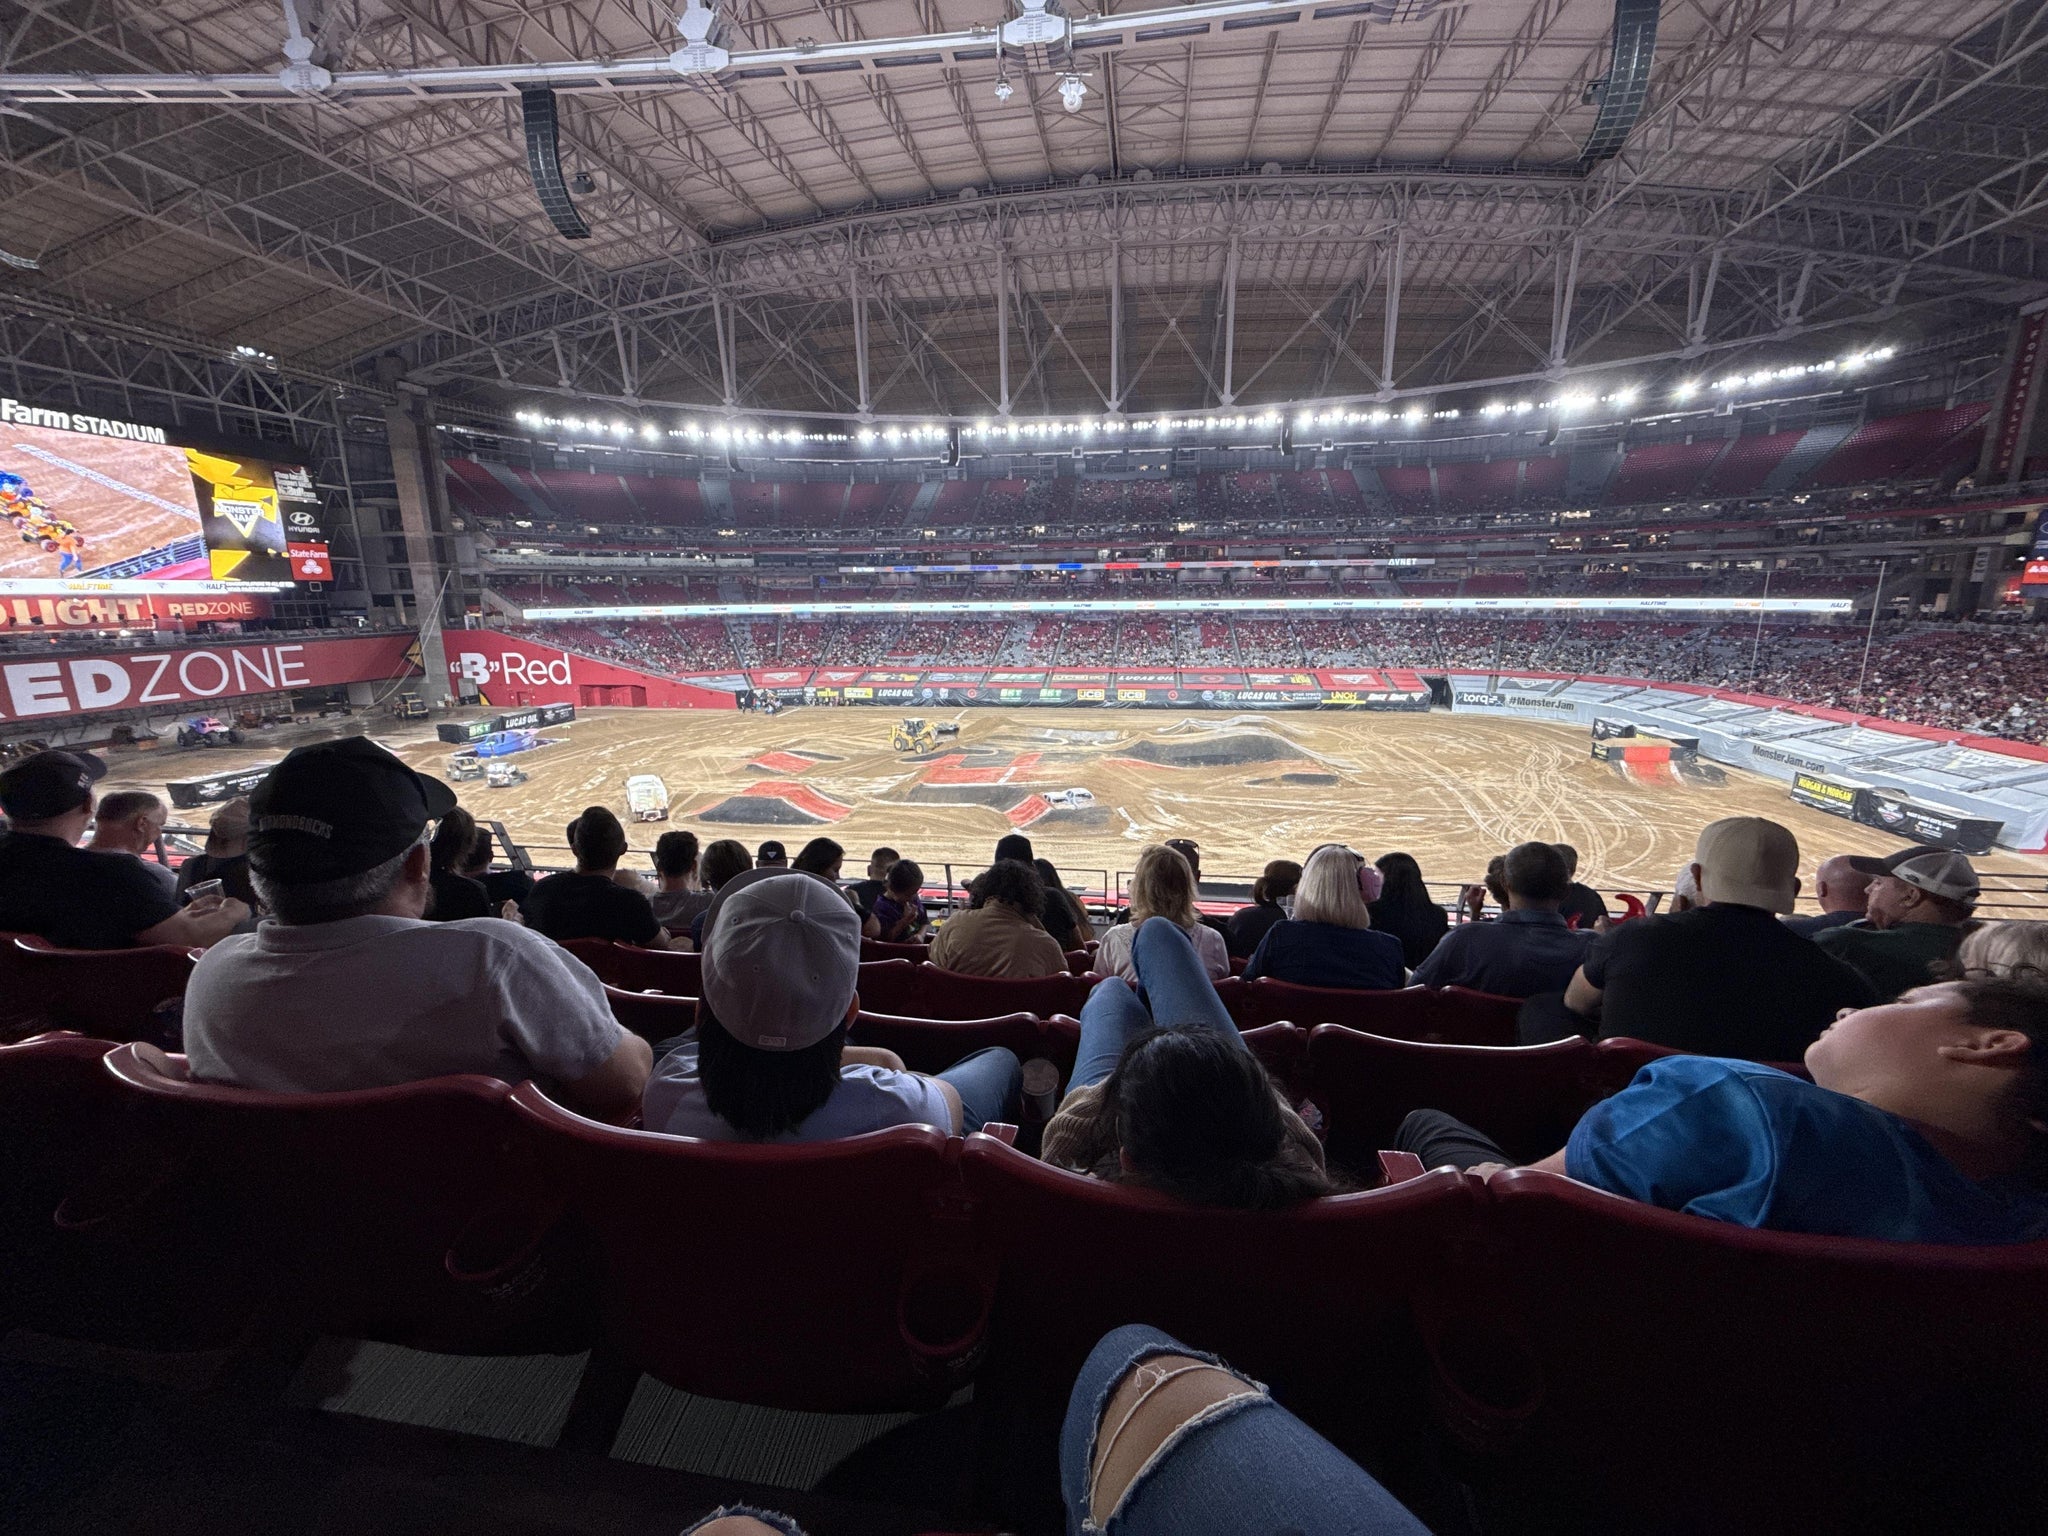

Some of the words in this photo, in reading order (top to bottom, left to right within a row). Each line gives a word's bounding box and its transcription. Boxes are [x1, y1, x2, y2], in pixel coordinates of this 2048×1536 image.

[1, 398, 69, 429] Farm
[72, 414, 166, 445] STADIUM
[168, 602, 254, 617] REDZONE
[0, 645, 311, 718] EDZONE
[878, 689, 901, 697] LUCAS
[1081, 690, 1103, 698] JCB
[1120, 690, 1143, 698] JCB
[1237, 692, 1262, 700] LUCAS
[1264, 692, 1277, 700] OIL
[1509, 695, 1575, 711] #MonsterJam
[505, 716, 527, 728] LUCAS
[527, 714, 538, 724] OIL
[1752, 745, 1825, 773] MonsterJam.com
